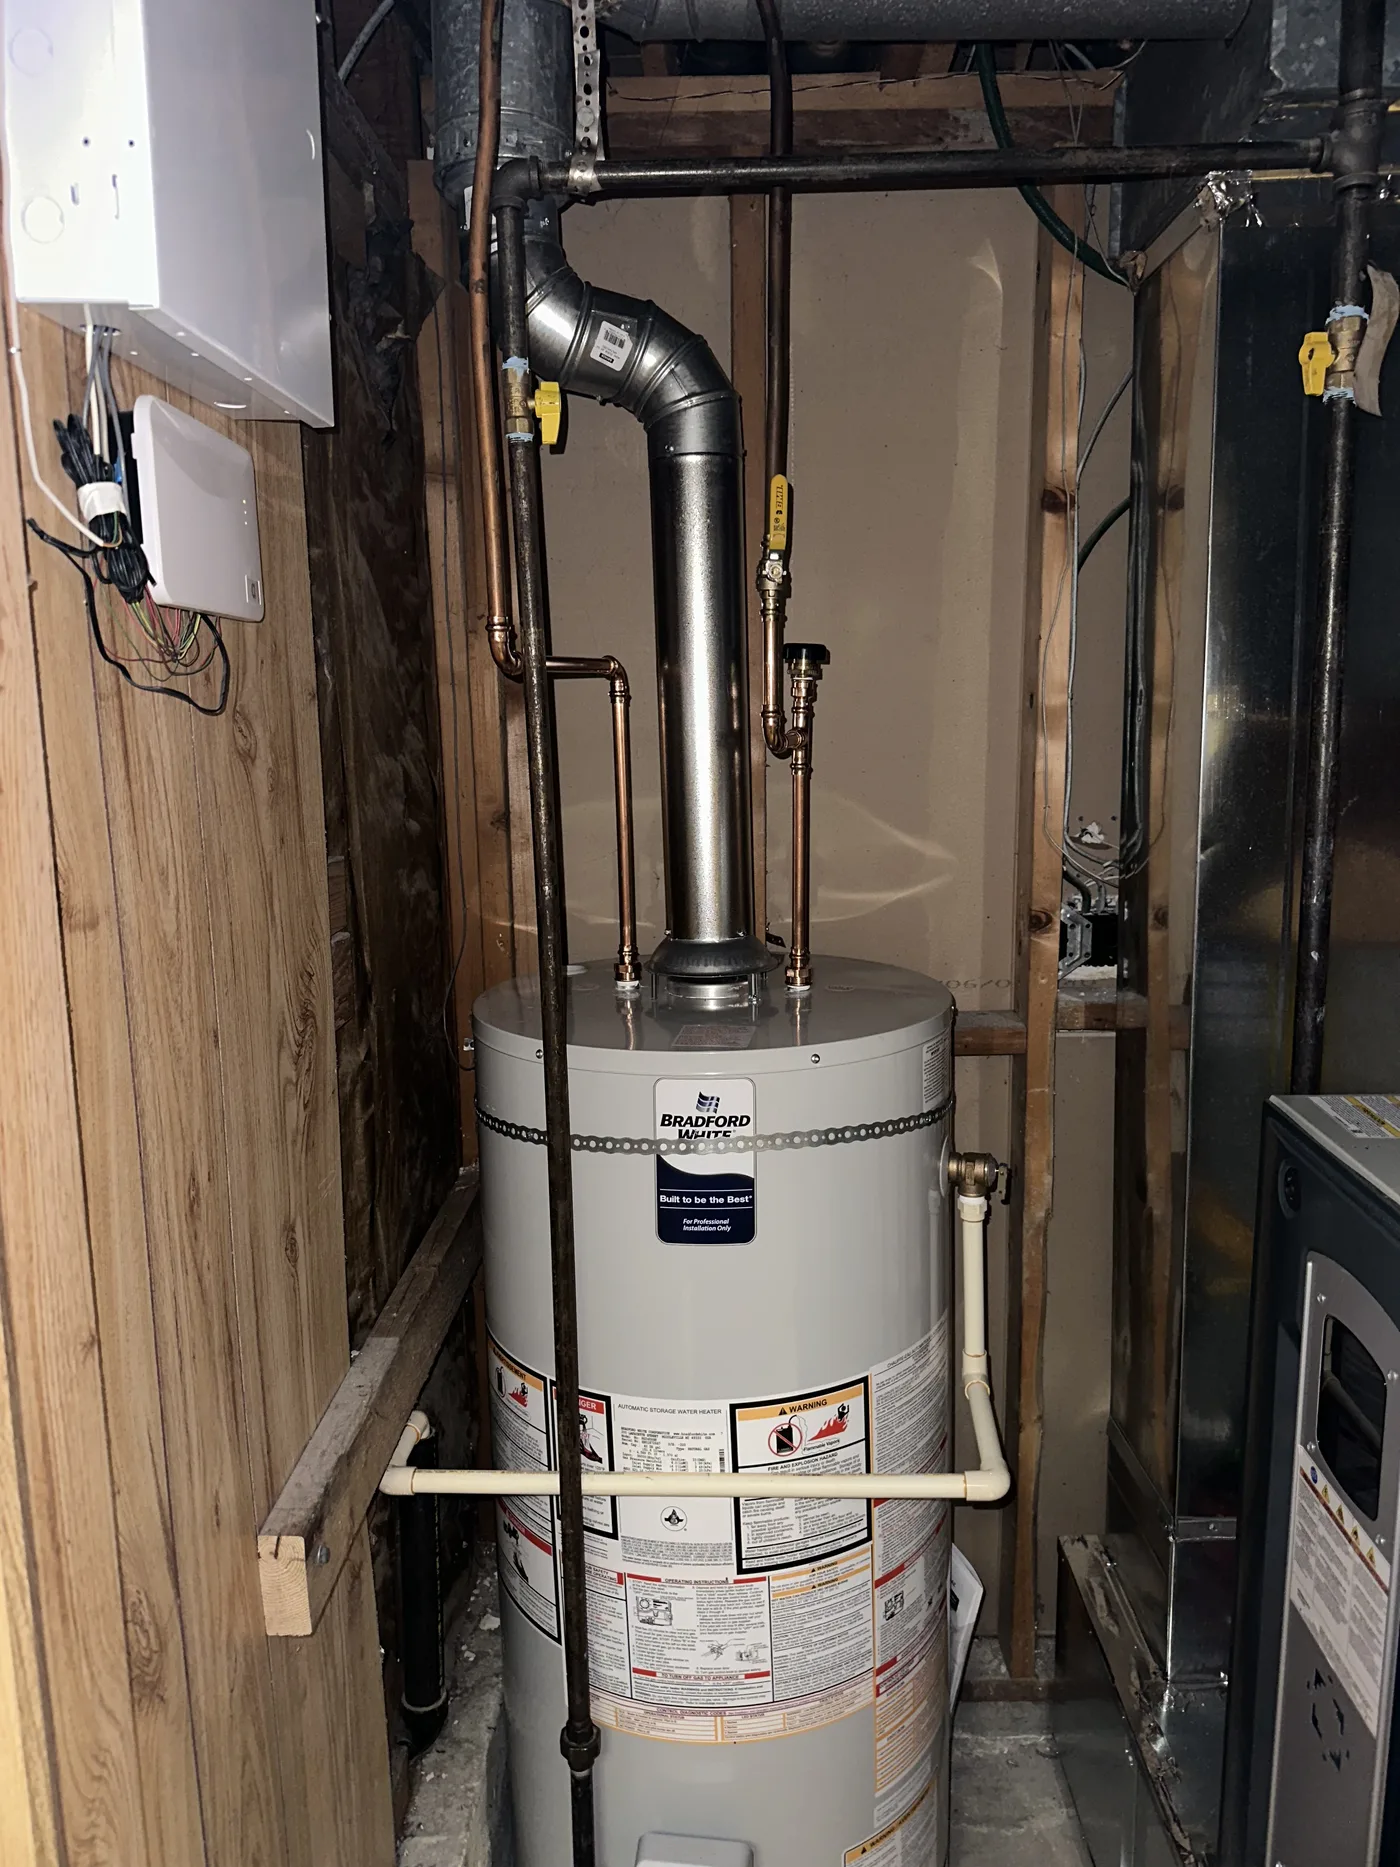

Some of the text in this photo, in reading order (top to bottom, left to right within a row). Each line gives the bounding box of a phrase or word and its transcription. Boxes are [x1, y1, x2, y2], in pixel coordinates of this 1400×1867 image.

[660, 1114, 751, 1128] BRADFORD
[660, 1195, 680, 1203] Built
[694, 1195, 706, 1203] be
[618, 1404, 648, 1412] AUTOMATIC
[789, 1399, 827, 1413] WARNING
[792, 1458, 818, 1468] EXPLOSION
[817, 1562, 838, 1570] WARNING
[593, 1571, 617, 1581] OPERATING
[817, 1578, 838, 1587] WARNING
